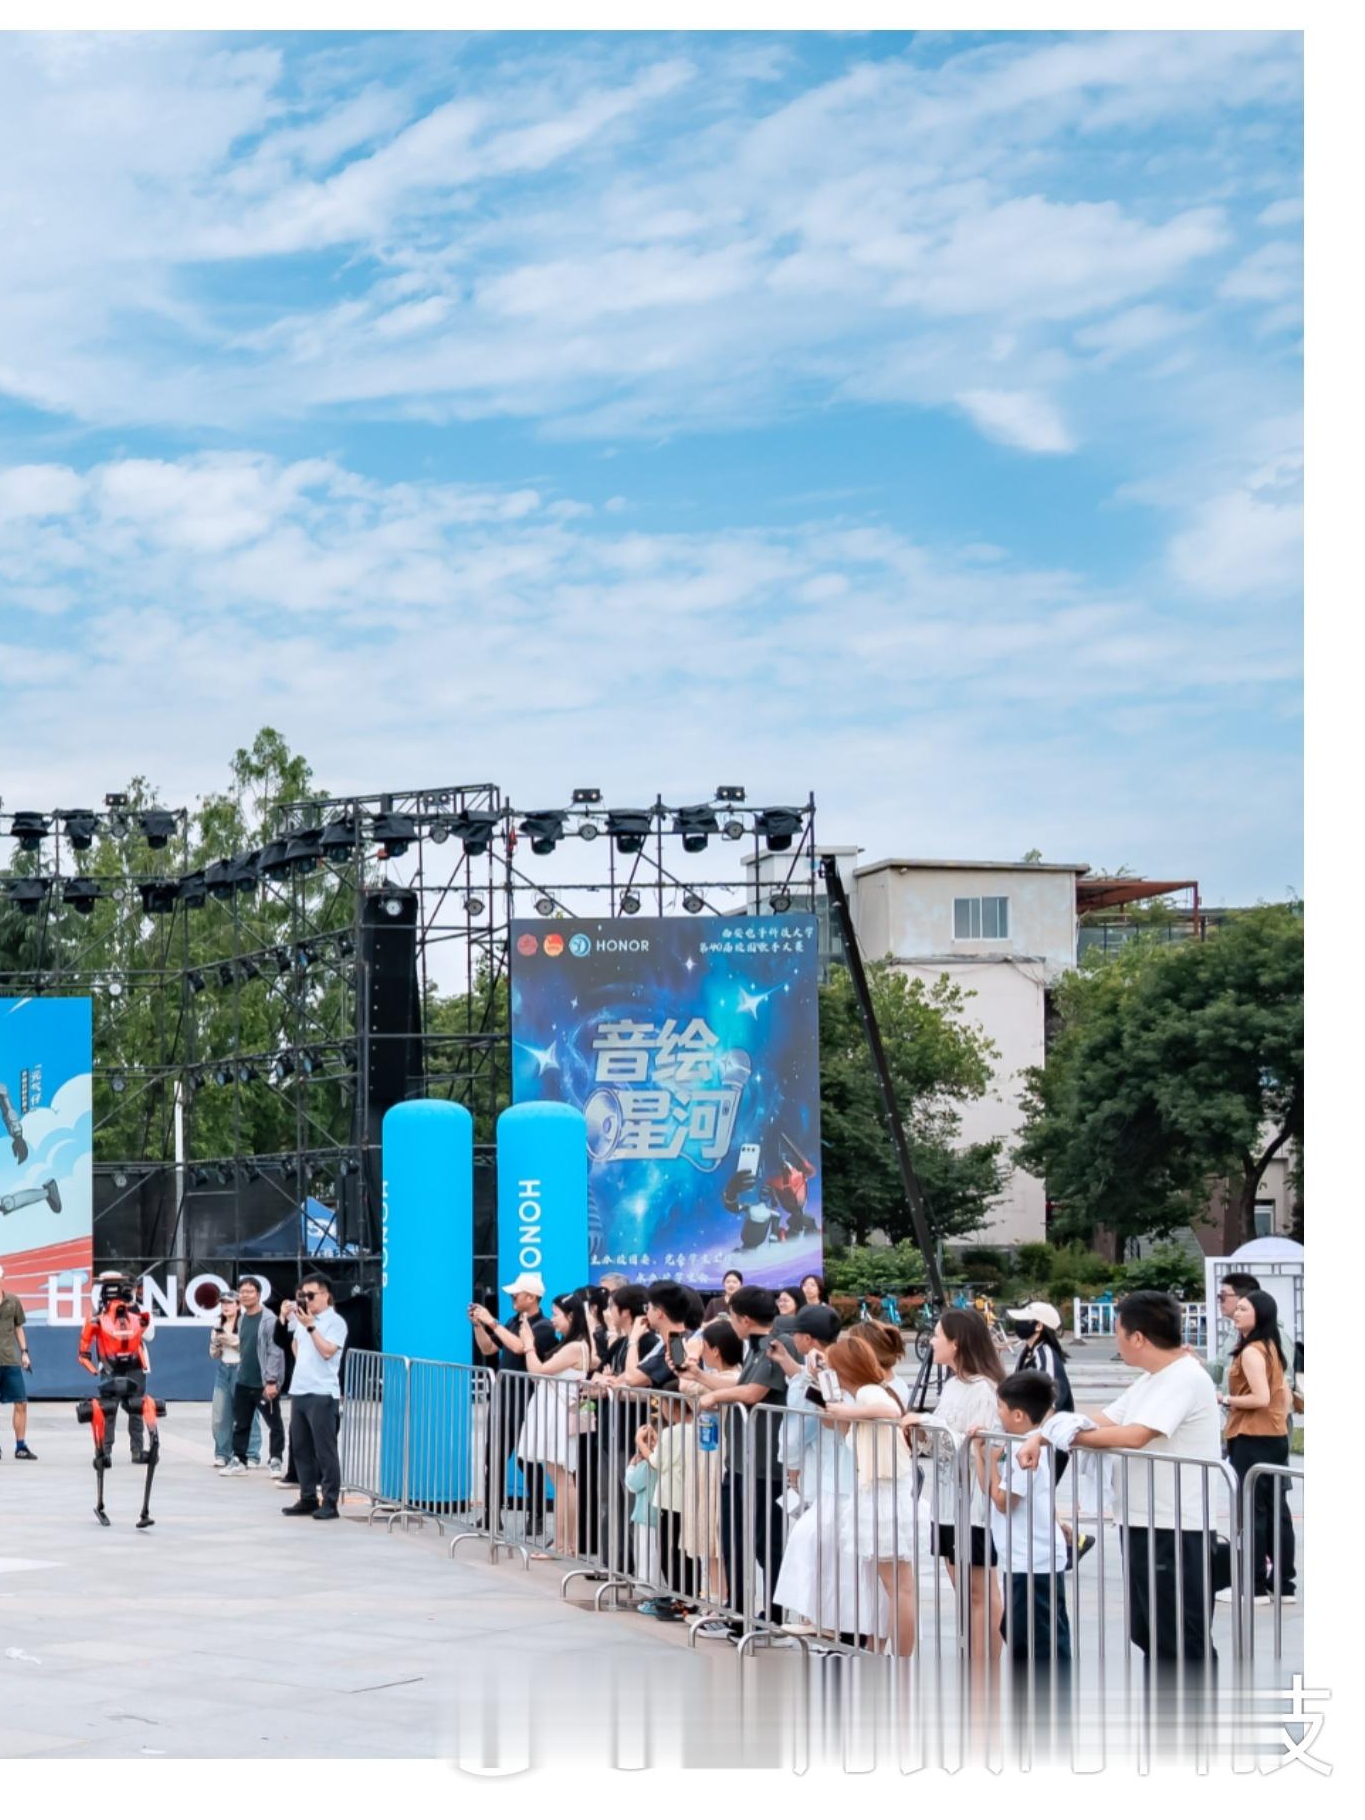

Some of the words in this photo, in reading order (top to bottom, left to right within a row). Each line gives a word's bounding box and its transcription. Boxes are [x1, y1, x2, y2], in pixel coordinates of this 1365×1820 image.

[595, 939, 650, 953] HONOR
[592, 1017, 719, 1082] 音绘
[622, 1087, 735, 1160] 星河
[517, 1178, 542, 1271] HONO
